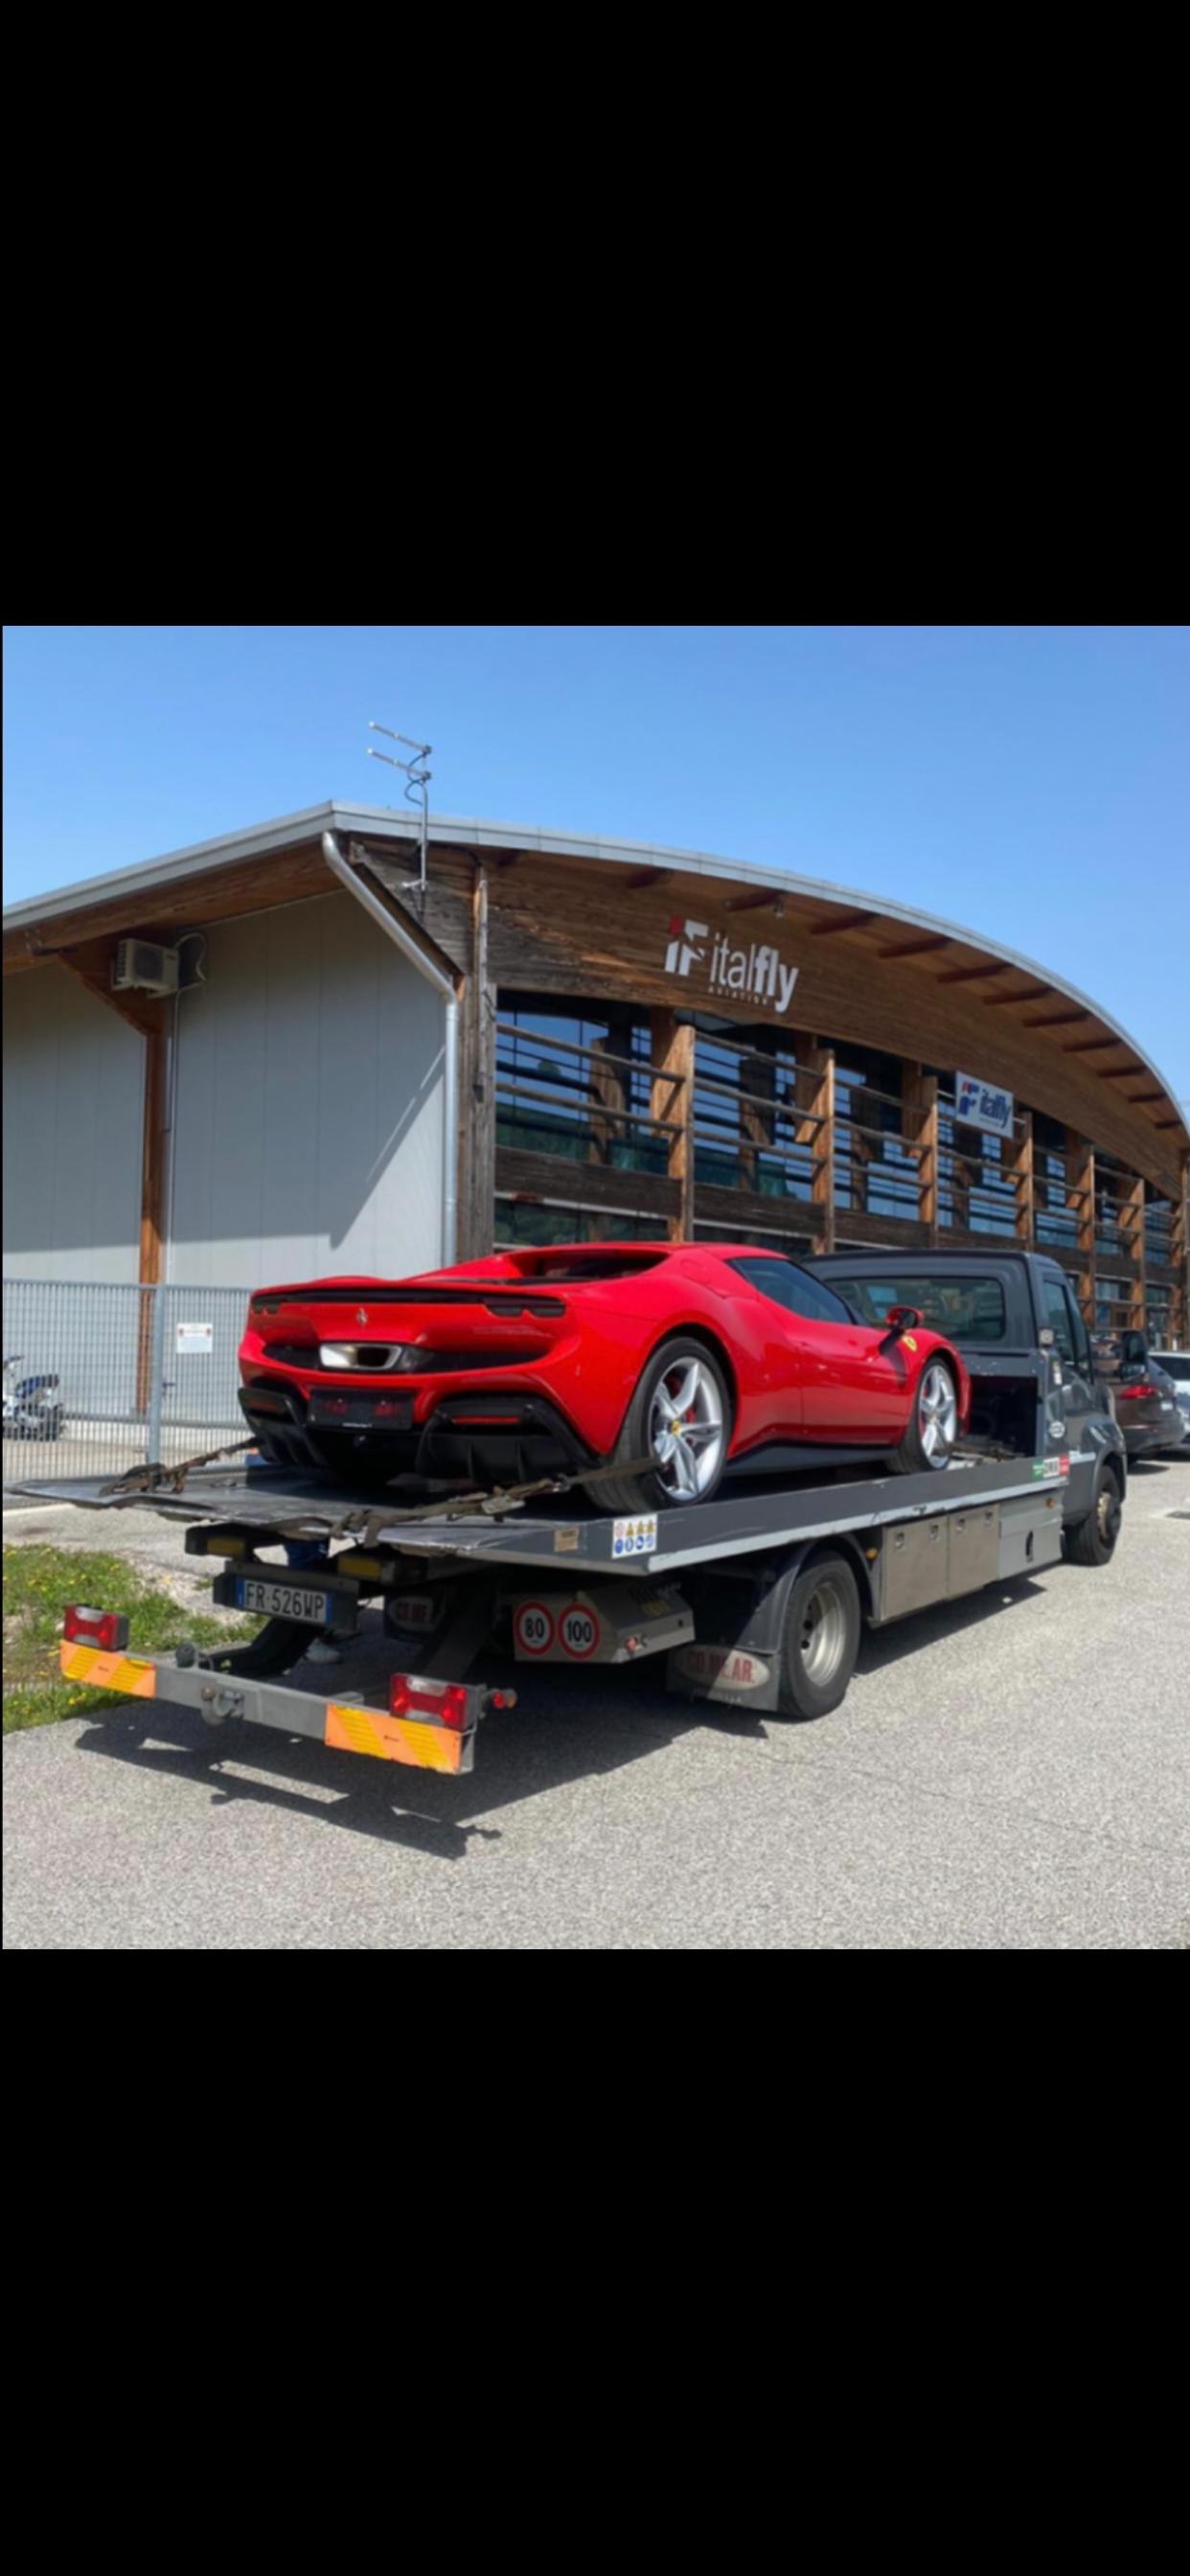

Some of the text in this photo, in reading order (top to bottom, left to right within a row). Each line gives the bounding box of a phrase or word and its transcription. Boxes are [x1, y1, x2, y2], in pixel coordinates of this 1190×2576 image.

[709, 932, 799, 1014] italfly
[271, 1588, 324, 1620] 526WP
[525, 1618, 545, 1638] 80
[567, 1621, 592, 1643] 100
